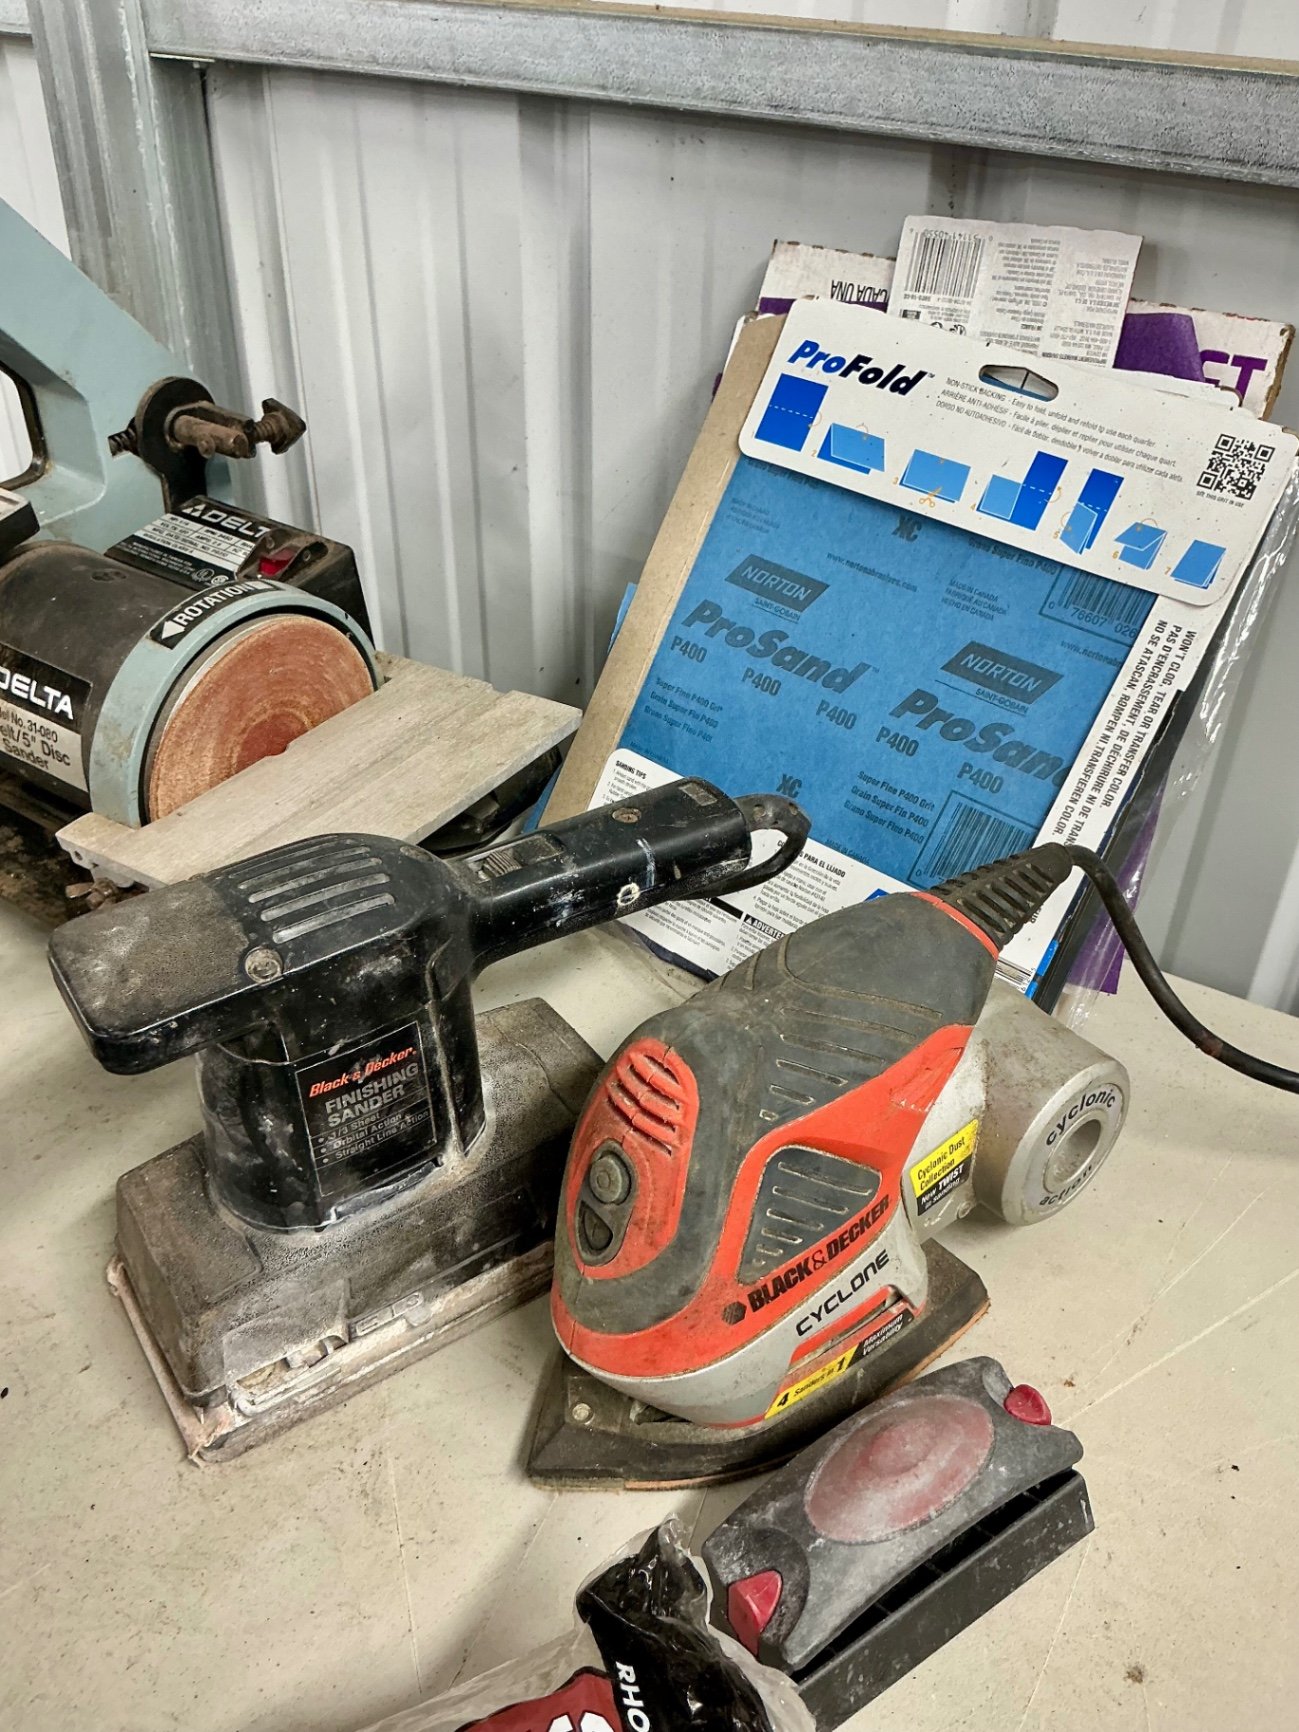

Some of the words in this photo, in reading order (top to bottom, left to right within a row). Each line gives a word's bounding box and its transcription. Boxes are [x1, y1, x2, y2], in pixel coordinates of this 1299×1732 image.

[830, 280, 854, 301] UNA
[858, 284, 888, 302] CADA
[1012, 398, 1026, 409] Easy
[1048, 410, 1067, 422] unfold
[1068, 416, 1080, 425] and
[1080, 420, 1098, 430] refold
[1106, 428, 1117, 436] use
[1118, 431, 1132, 440] each
[956, 405, 964, 414] NO
[1154, 469, 1168, 478] cada
[1013, 411, 1030, 422] Facile
[1136, 450, 1158, 462] chaque
[1112, 550, 1119, 560] 6
[742, 566, 811, 600] NORTON
[174, 582, 254, 626] ROTATION
[755, 597, 800, 622] SAINT-GOBAIN
[1048, 602, 1055, 610] 0
[1070, 607, 1108, 628] 76607
[1148, 634, 1160, 648] SE
[1154, 620, 1168, 634] NO
[1166, 624, 1183, 645] PAS
[671, 636, 708, 663] P400
[1176, 630, 1198, 661] WON'T
[742, 667, 782, 696] P400
[961, 654, 1042, 692] NORTON
[1122, 647, 1154, 691] ATASCAN,
[1159, 662, 1181, 688] CLOG,
[0, 666, 74, 720] DELTA
[976, 688, 1028, 713] SAINT-GOBAIN
[1121, 644, 1172, 727] D'ENCRASSEMENT,
[816, 700, 858, 730] P400
[1104, 692, 1131, 735] ROMPEN
[1147, 691, 1167, 716] TEAR
[11, 711, 26, 728] No.
[27, 720, 58, 743] 31-080
[1116, 729, 1130, 744] DE
[1139, 715, 1154, 730] OR
[3, 738, 48, 770] Sander
[42, 740, 70, 766] Disc
[876, 726, 920, 758] P400
[1116, 730, 1147, 778] TRANSFER
[616, 760, 636, 774] SANDING
[636, 770, 647, 780] TIPS
[957, 762, 1004, 794] P400
[1068, 744, 1104, 805] TRANSFIEREN
[1090, 743, 1122, 794] DÉCHIRURE
[776, 773, 802, 798] XC
[858, 770, 880, 786] Super
[880, 781, 898, 795] Fine
[898, 788, 920, 804] P400
[920, 798, 935, 812] Grit
[1085, 793, 1098, 806] NI
[1099, 777, 1122, 808] COLOR.
[851, 785, 872, 800] Grain
[872, 794, 894, 812] Super
[895, 804, 908, 818] Fin
[908, 811, 930, 828] P400
[1052, 806, 1076, 836] COLOR.
[1078, 805, 1092, 820] DE
[866, 810, 886, 826] Super
[886, 820, 904, 835] Fino
[904, 828, 924, 844] P400
[804, 853, 818, 865] PARA
[819, 860, 826, 868] EL
[826, 864, 846, 878] LIJADO
[309, 1072, 349, 1098] Black
[325, 1062, 418, 1114] FINISHING
[328, 1084, 404, 1127] SANDER
[1046, 1088, 1116, 1146] cyclonic
[333, 1128, 368, 1150] Orbital
[370, 1114, 402, 1132] Action
[335, 1138, 376, 1160] Straight
[376, 1126, 398, 1141] Line
[400, 1110, 429, 1130] Action
[351, 1113, 380, 1131] Sheet
[918, 1152, 948, 1180] Cyclonic
[948, 1136, 965, 1155] Dust
[920, 1158, 955, 1191] Collection
[938, 1164, 964, 1190] TWIST
[796, 1249, 890, 1337] CYCLONE
[864, 1314, 904, 1348] Maximum
[777, 1392, 790, 1407] 4
[794, 1375, 825, 1397] Sanders
[836, 1356, 846, 1373] 1
